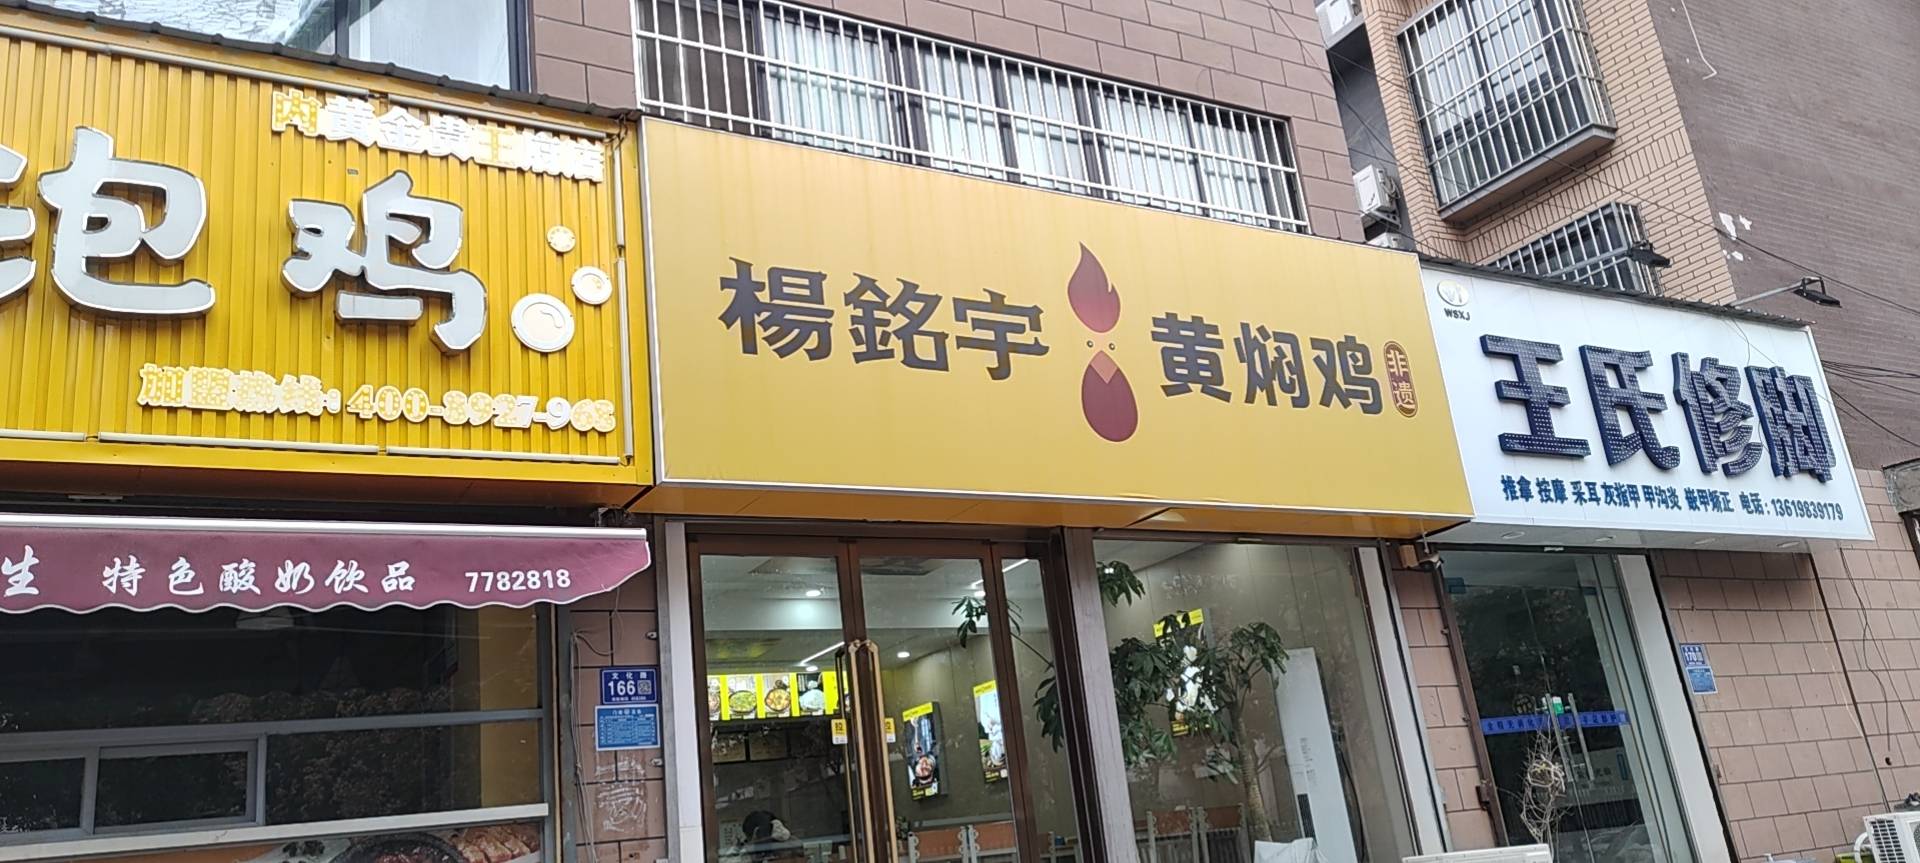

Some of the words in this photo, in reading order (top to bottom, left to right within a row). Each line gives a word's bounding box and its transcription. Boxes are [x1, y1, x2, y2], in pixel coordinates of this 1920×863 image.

[718, 256, 1050, 381] 楊銘宇
[1443, 307, 1471, 321] WSXJ
[1151, 311, 1383, 415] 黄焖鸡
[1386, 348, 1416, 410] 非遗
[1480, 334, 1836, 483] 王氏修脚
[1501, 474, 1534, 502] 推拿
[1535, 477, 1568, 504] 按摩
[1570, 480, 1602, 507] 采耳
[1641, 484, 1682, 511] 甲沟炎
[1, 545, 41, 596] 生
[102, 555, 416, 597] 特色酸奶饮品
[465, 568, 572, 593] 7782818
[608, 680, 636, 696] 166
